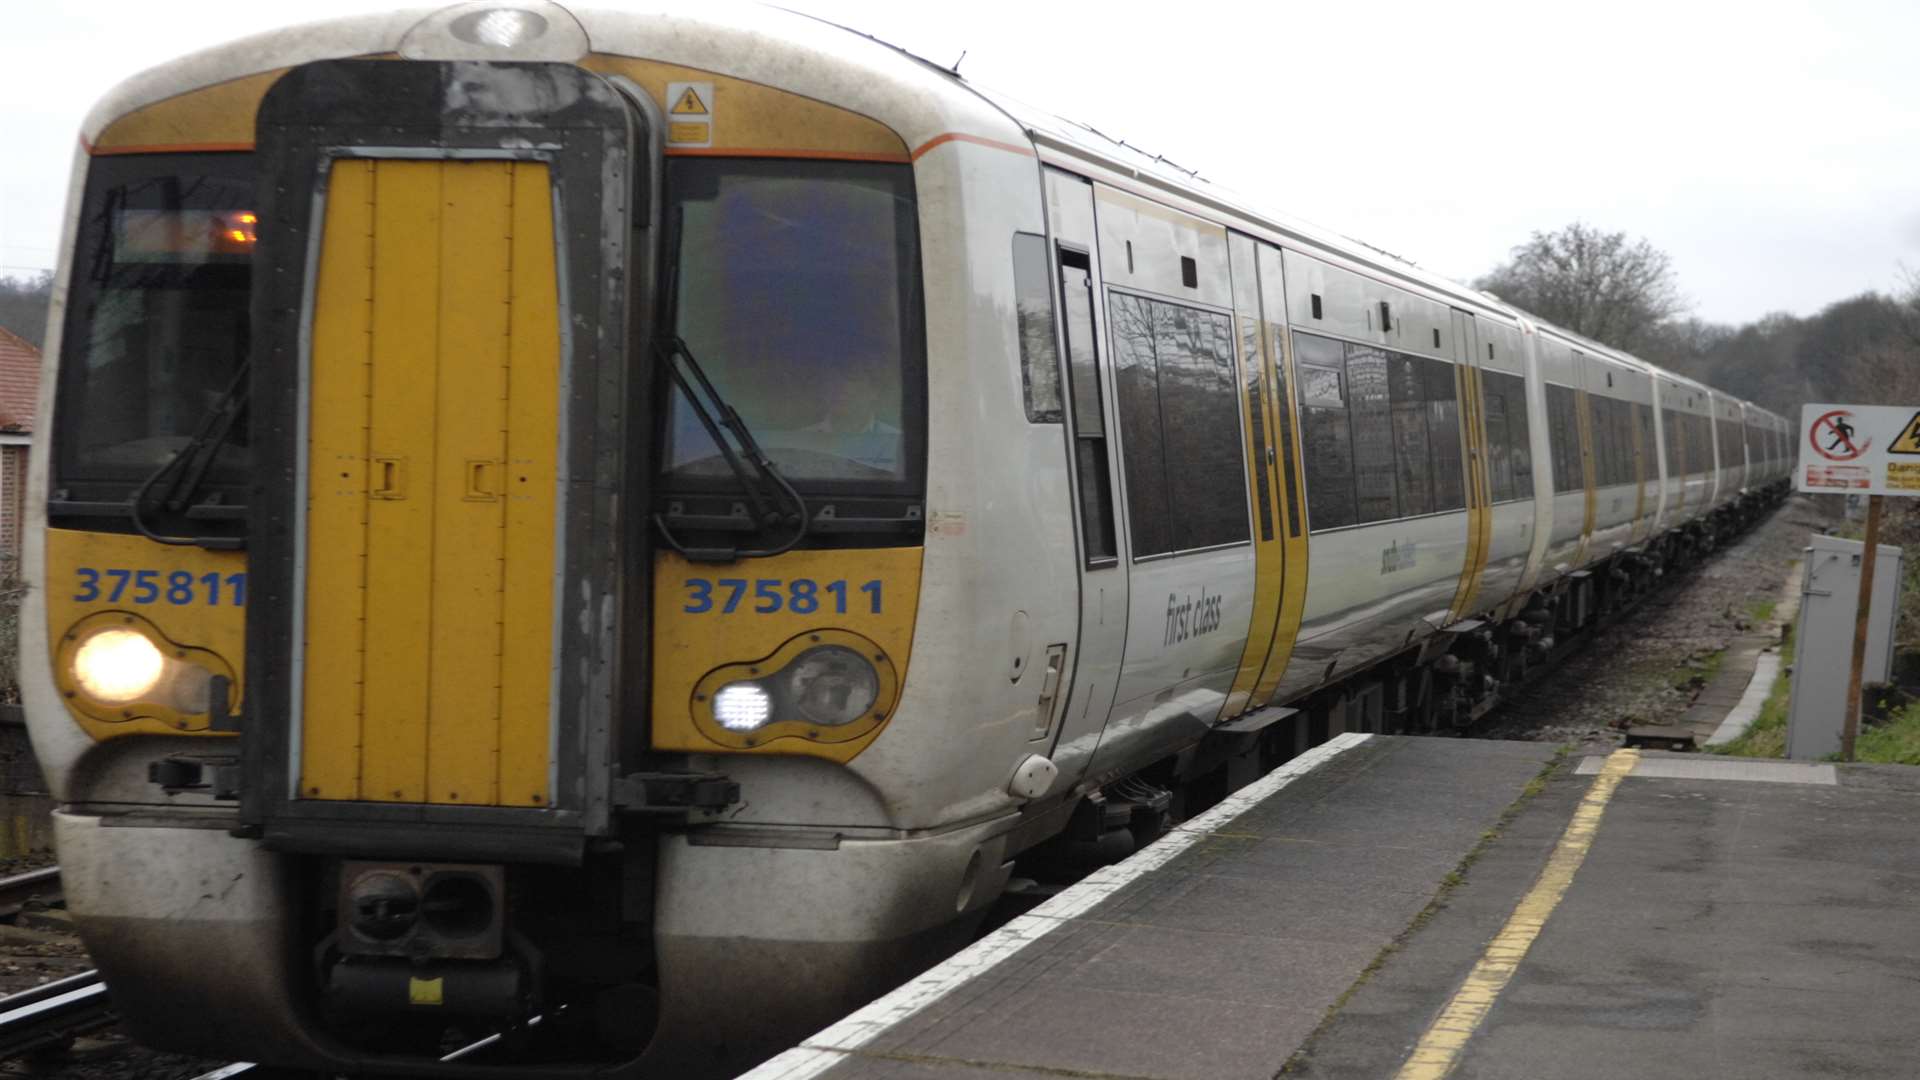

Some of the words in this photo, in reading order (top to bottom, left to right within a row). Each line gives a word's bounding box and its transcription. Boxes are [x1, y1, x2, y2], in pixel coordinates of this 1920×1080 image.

[74, 567, 247, 606] 375811
[683, 578, 882, 614] 375811
[1163, 592, 1192, 647] first
[1193, 585, 1222, 638] class
